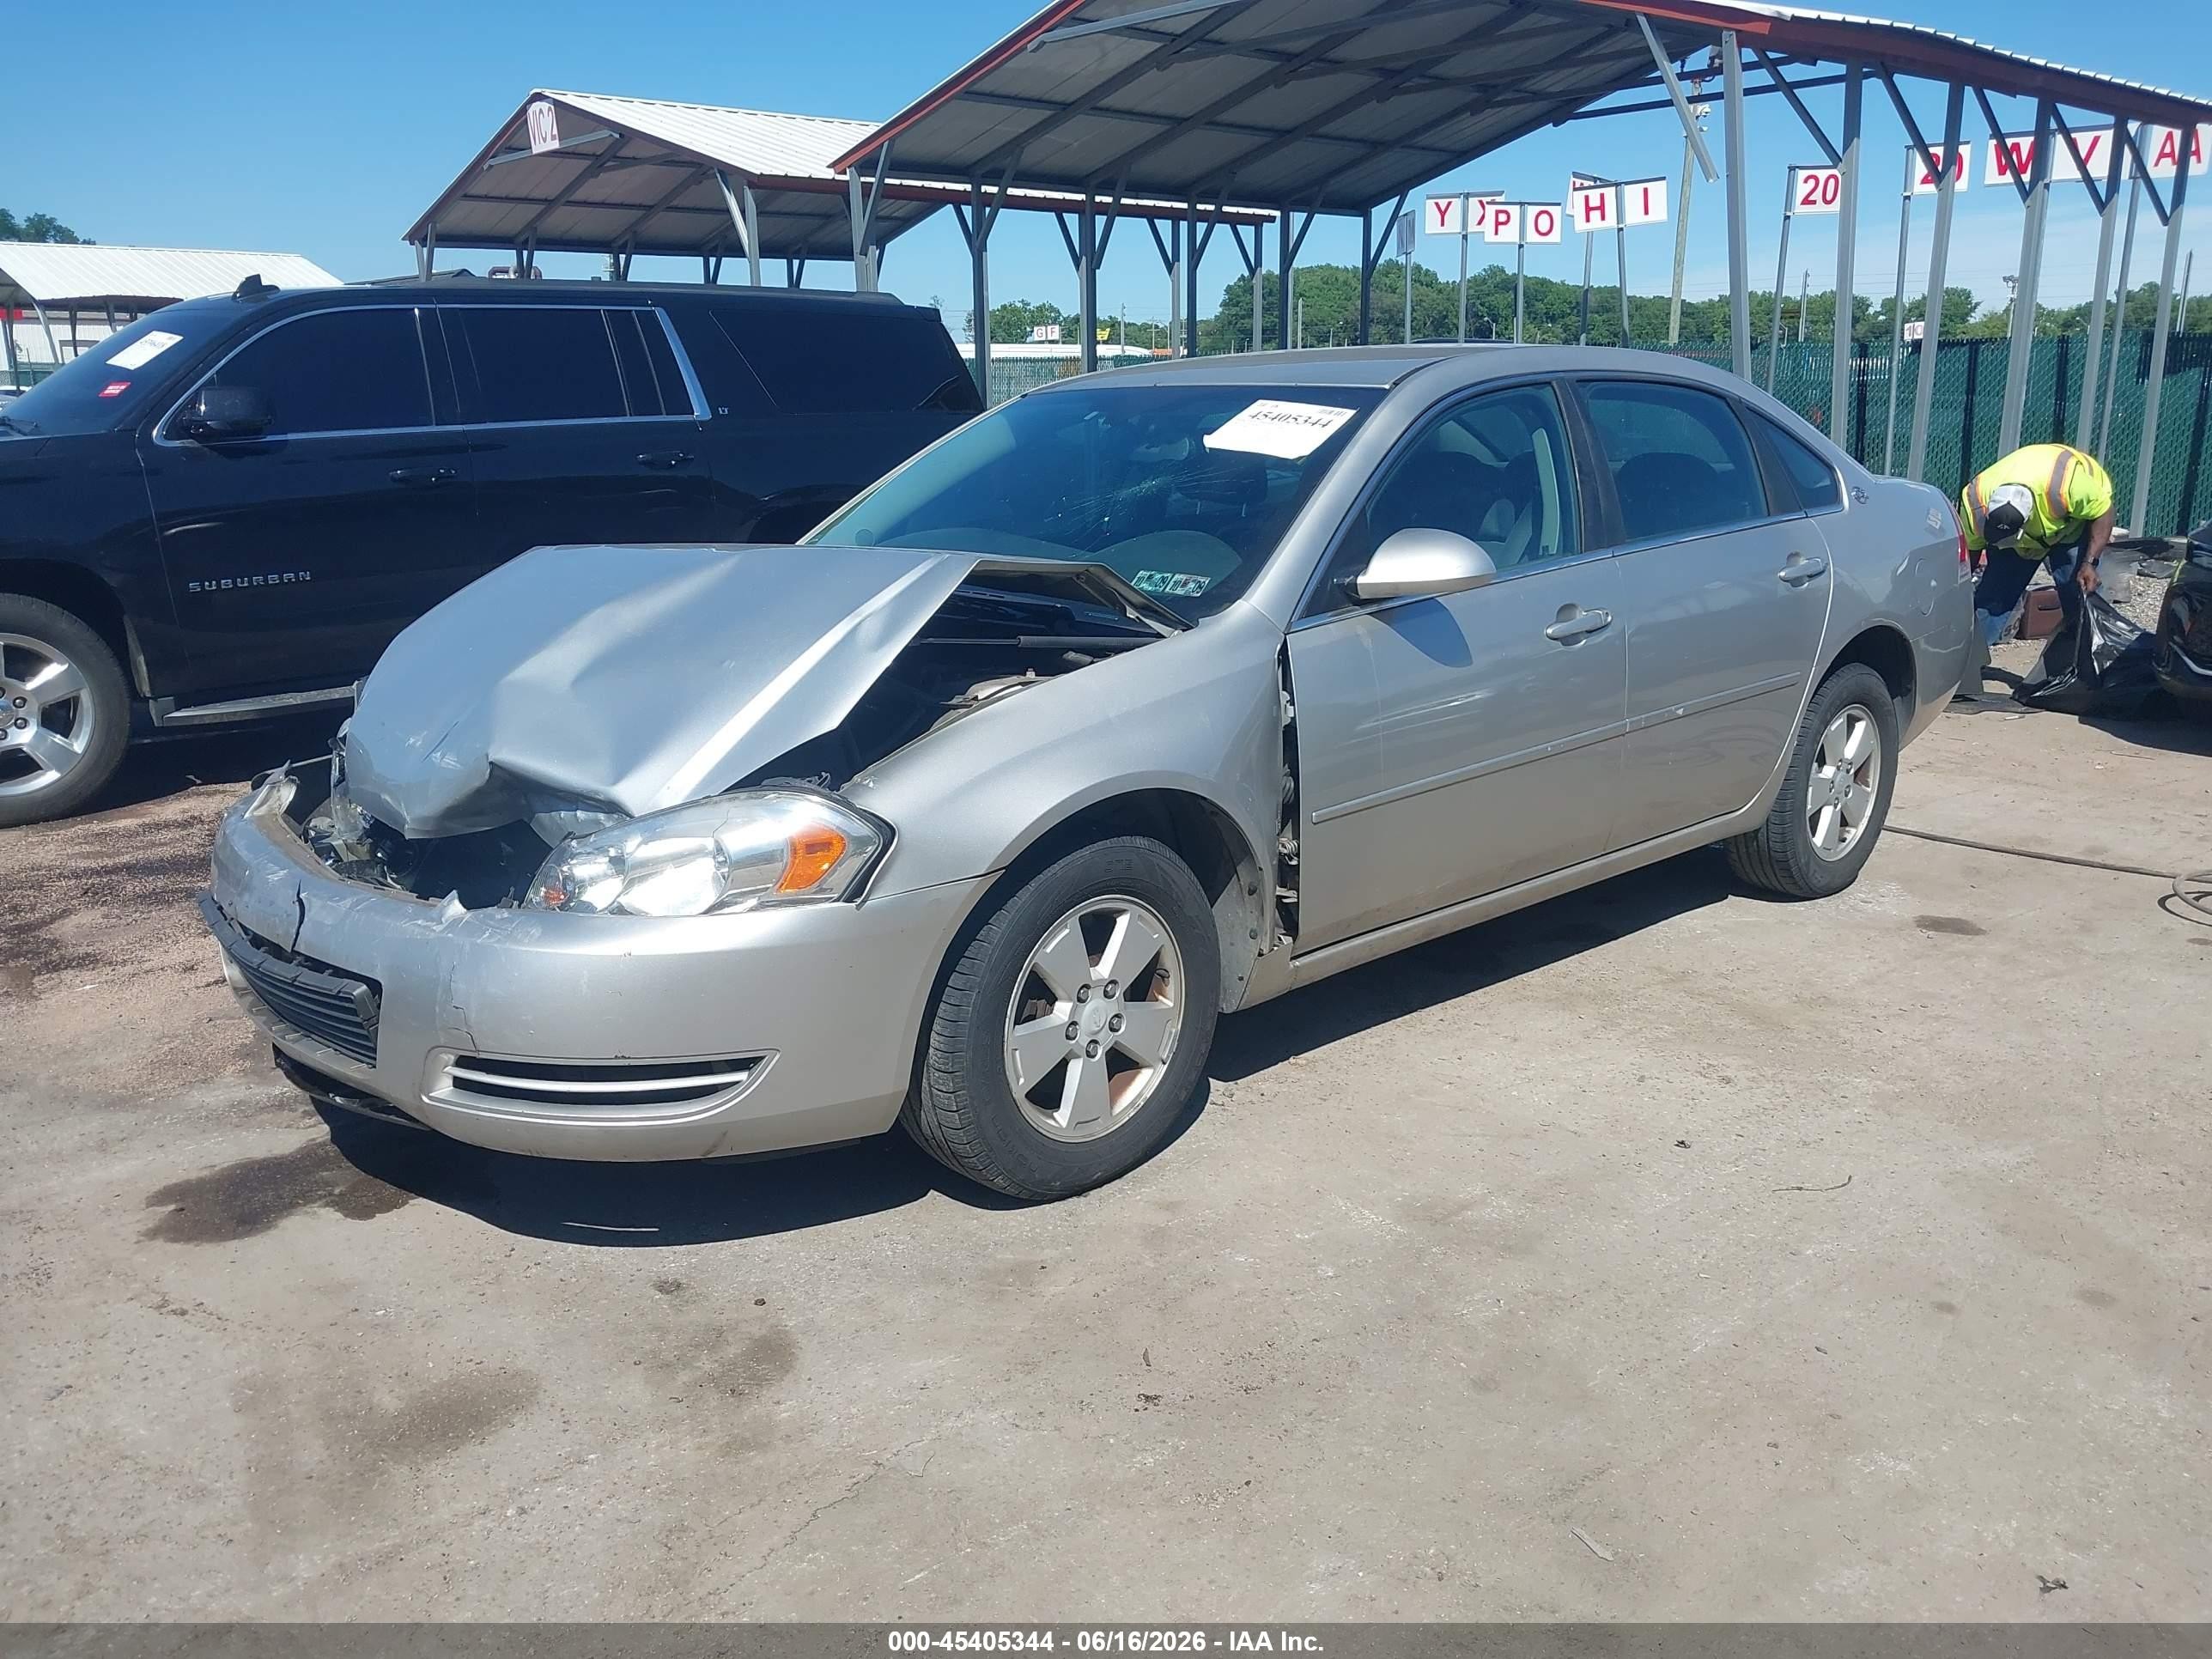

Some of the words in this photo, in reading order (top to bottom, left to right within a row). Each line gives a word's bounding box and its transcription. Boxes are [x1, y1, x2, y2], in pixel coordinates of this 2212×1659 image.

[528, 108, 548, 145] VIC
[548, 106, 557, 141] 2
[1800, 174, 1839, 205] 20
[1434, 200, 1453, 227] Y
[1584, 192, 1606, 222] H
[1643, 187, 1650, 216] I
[1494, 210, 1511, 235] P
[1534, 210, 1554, 236] O
[1036, 327, 1043, 338] G
[1050, 327, 1056, 337] F
[1249, 411, 1333, 428] 45405344
[189, 571, 312, 592] SUBURBAN
